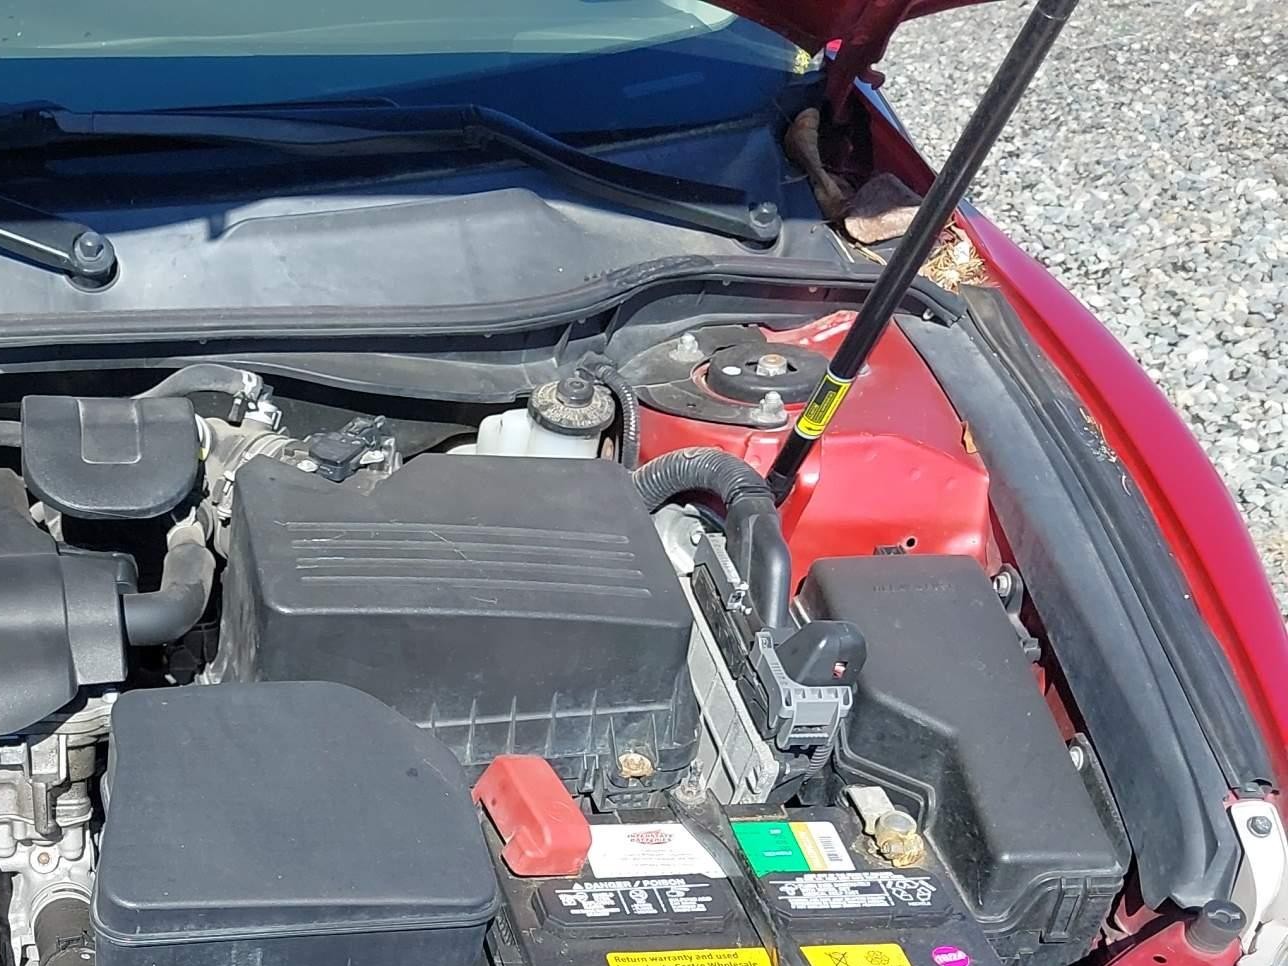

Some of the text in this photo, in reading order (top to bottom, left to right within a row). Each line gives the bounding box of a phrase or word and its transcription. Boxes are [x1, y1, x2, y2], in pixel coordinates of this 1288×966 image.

[584, 881, 632, 889] DANGER
[614, 951, 739, 963] Return warranty and used
